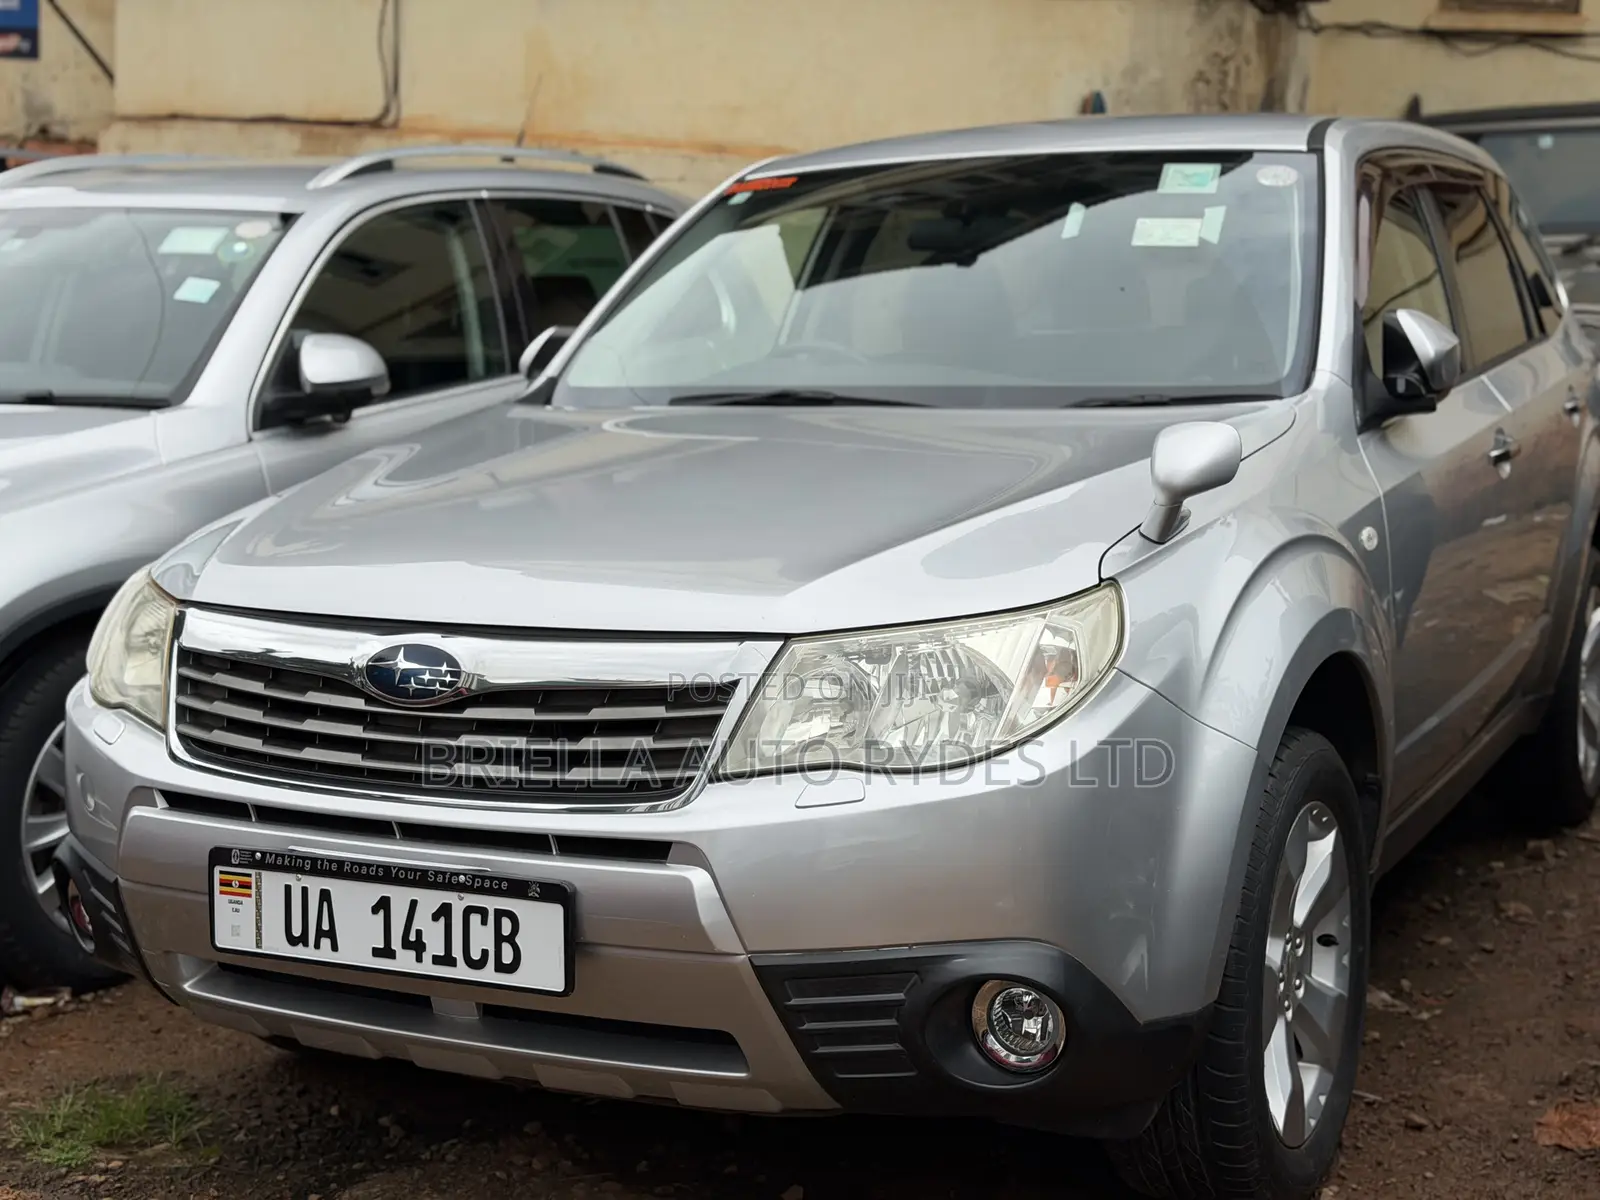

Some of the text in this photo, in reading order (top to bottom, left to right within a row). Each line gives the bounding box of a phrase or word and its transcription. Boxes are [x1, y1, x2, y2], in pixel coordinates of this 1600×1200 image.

[265, 852, 312, 871] Making
[317, 858, 339, 872] the
[344, 864, 384, 877] Roads
[391, 867, 422, 881] Your
[427, 870, 459, 885] Safe
[465, 874, 509, 890] Space
[284, 884, 522, 975] UA 141CB
